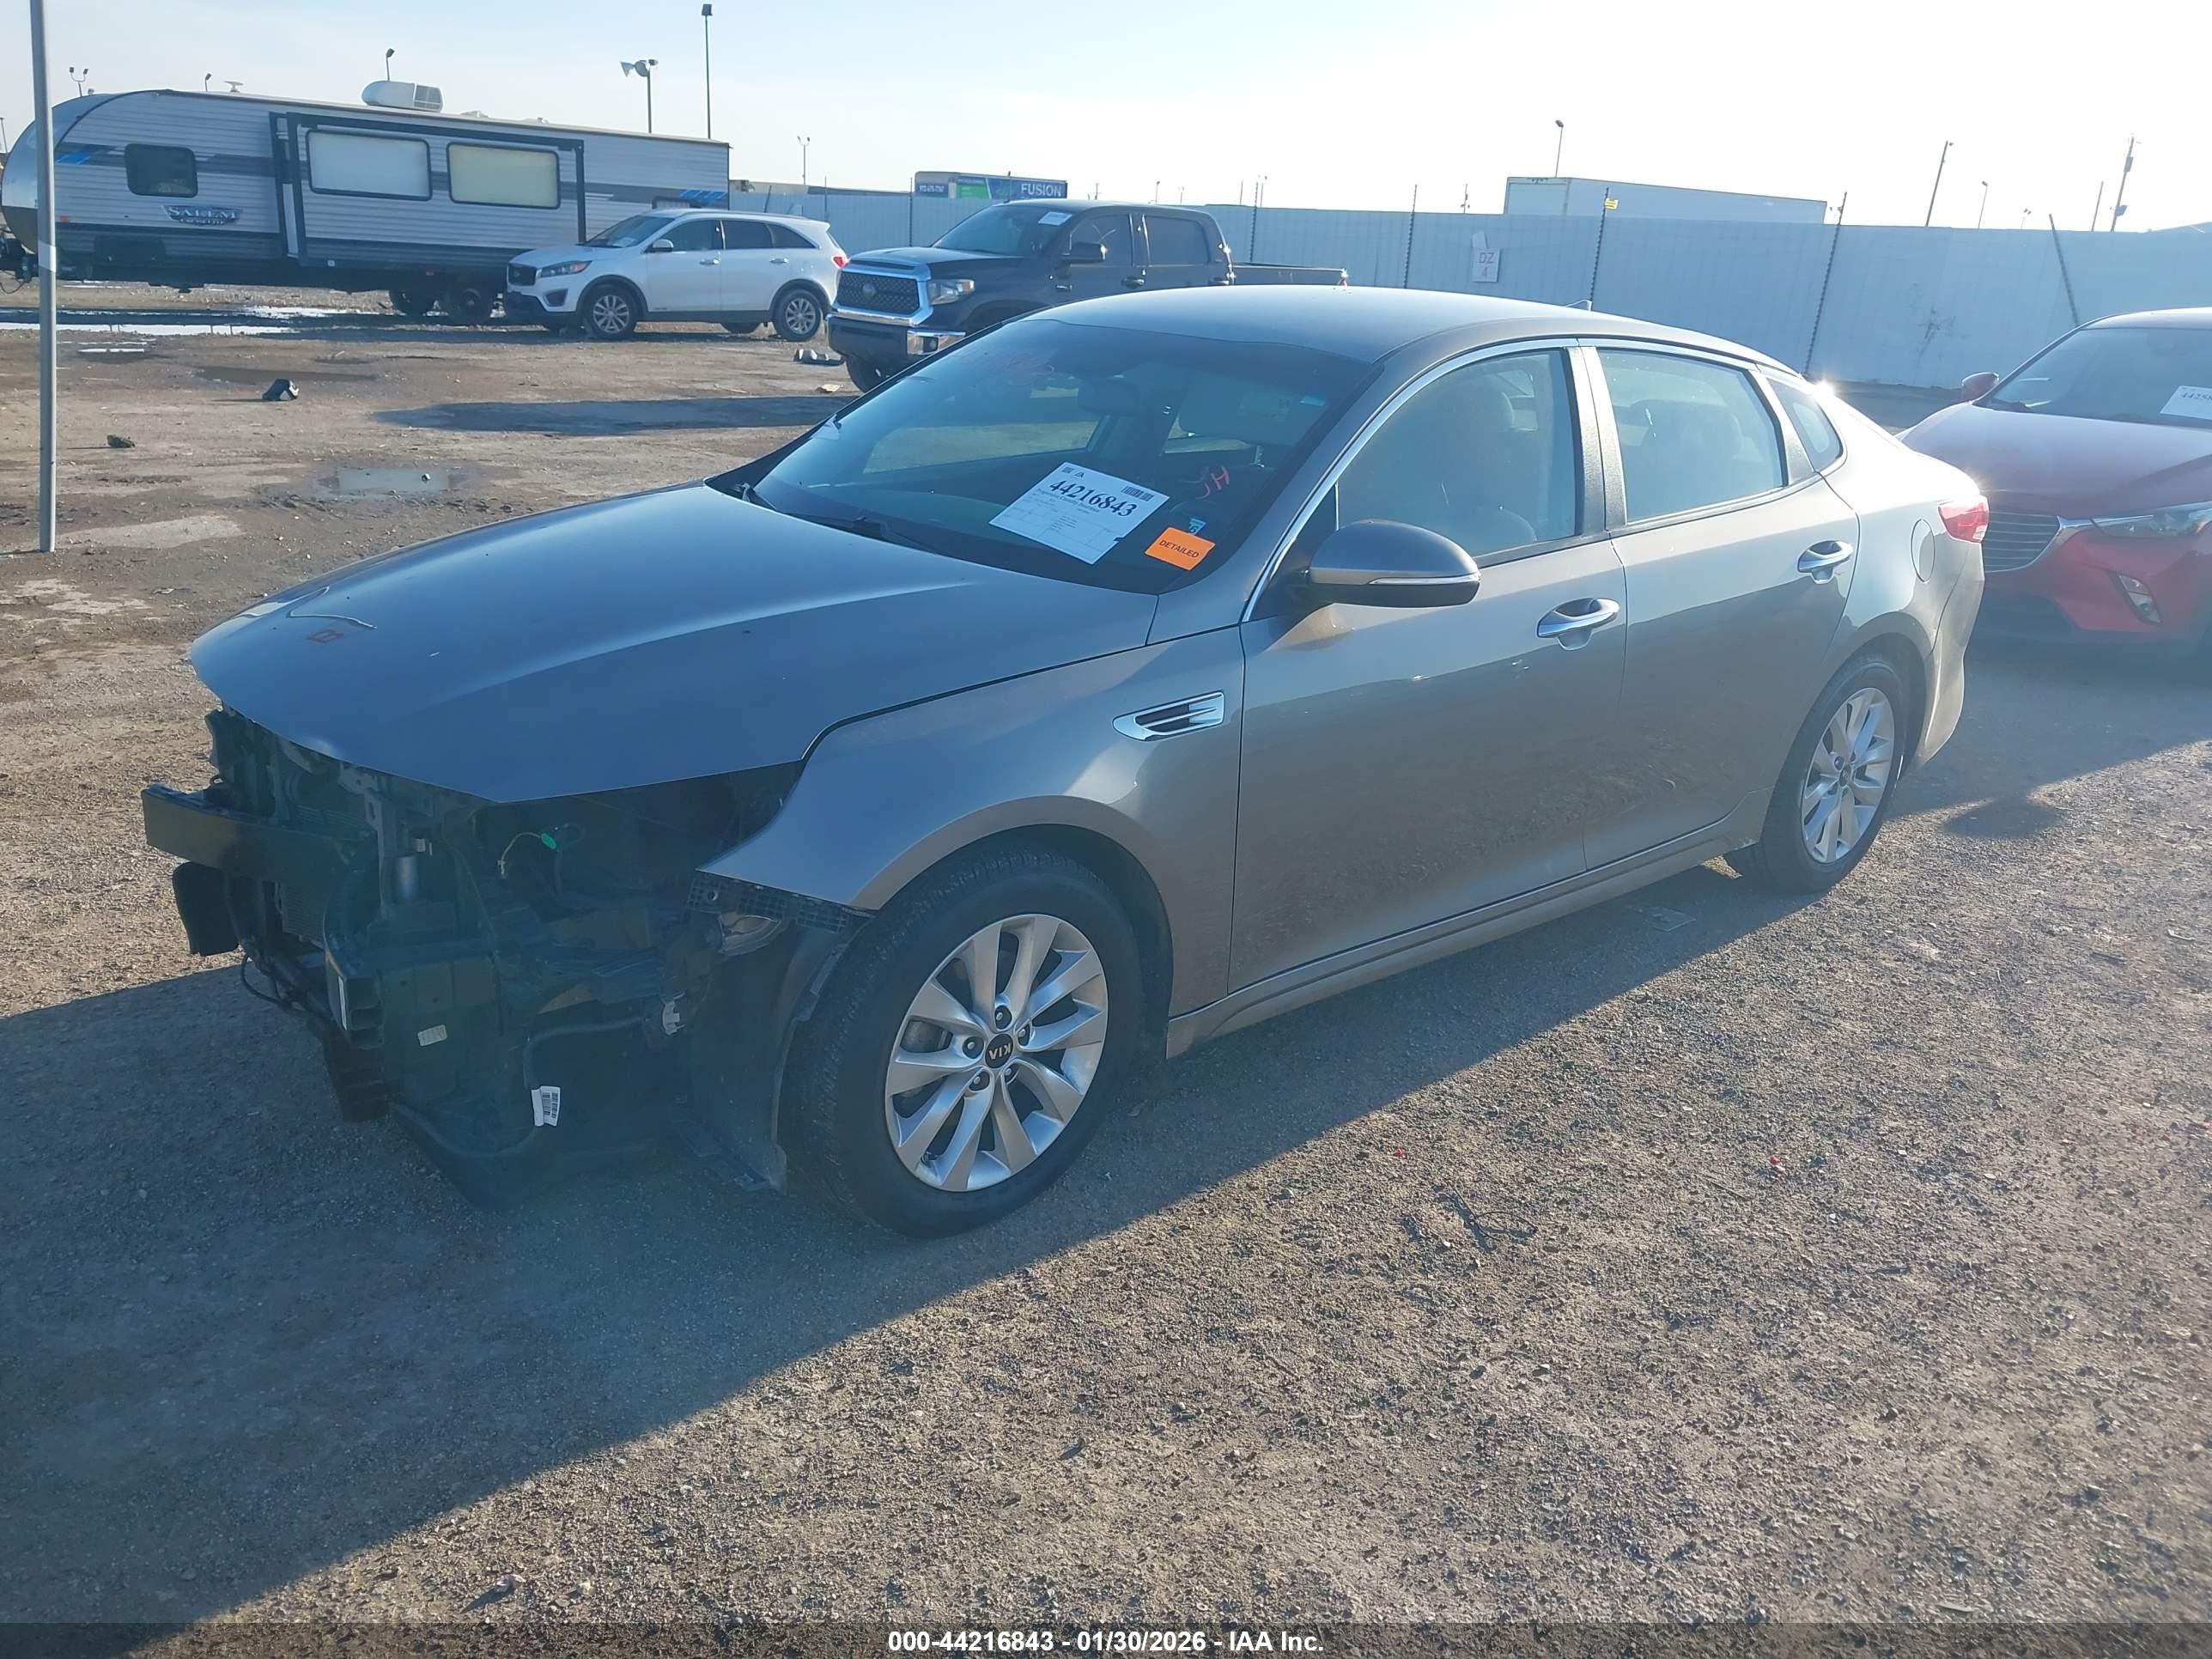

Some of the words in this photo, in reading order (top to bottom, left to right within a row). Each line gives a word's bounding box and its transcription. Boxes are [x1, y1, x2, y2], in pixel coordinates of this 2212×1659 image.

[1021, 182, 1061, 197] FUSION
[168, 208, 235, 219] SALEM
[1049, 480, 1137, 517] 44216843
[1159, 539, 1200, 558] DETAILED
